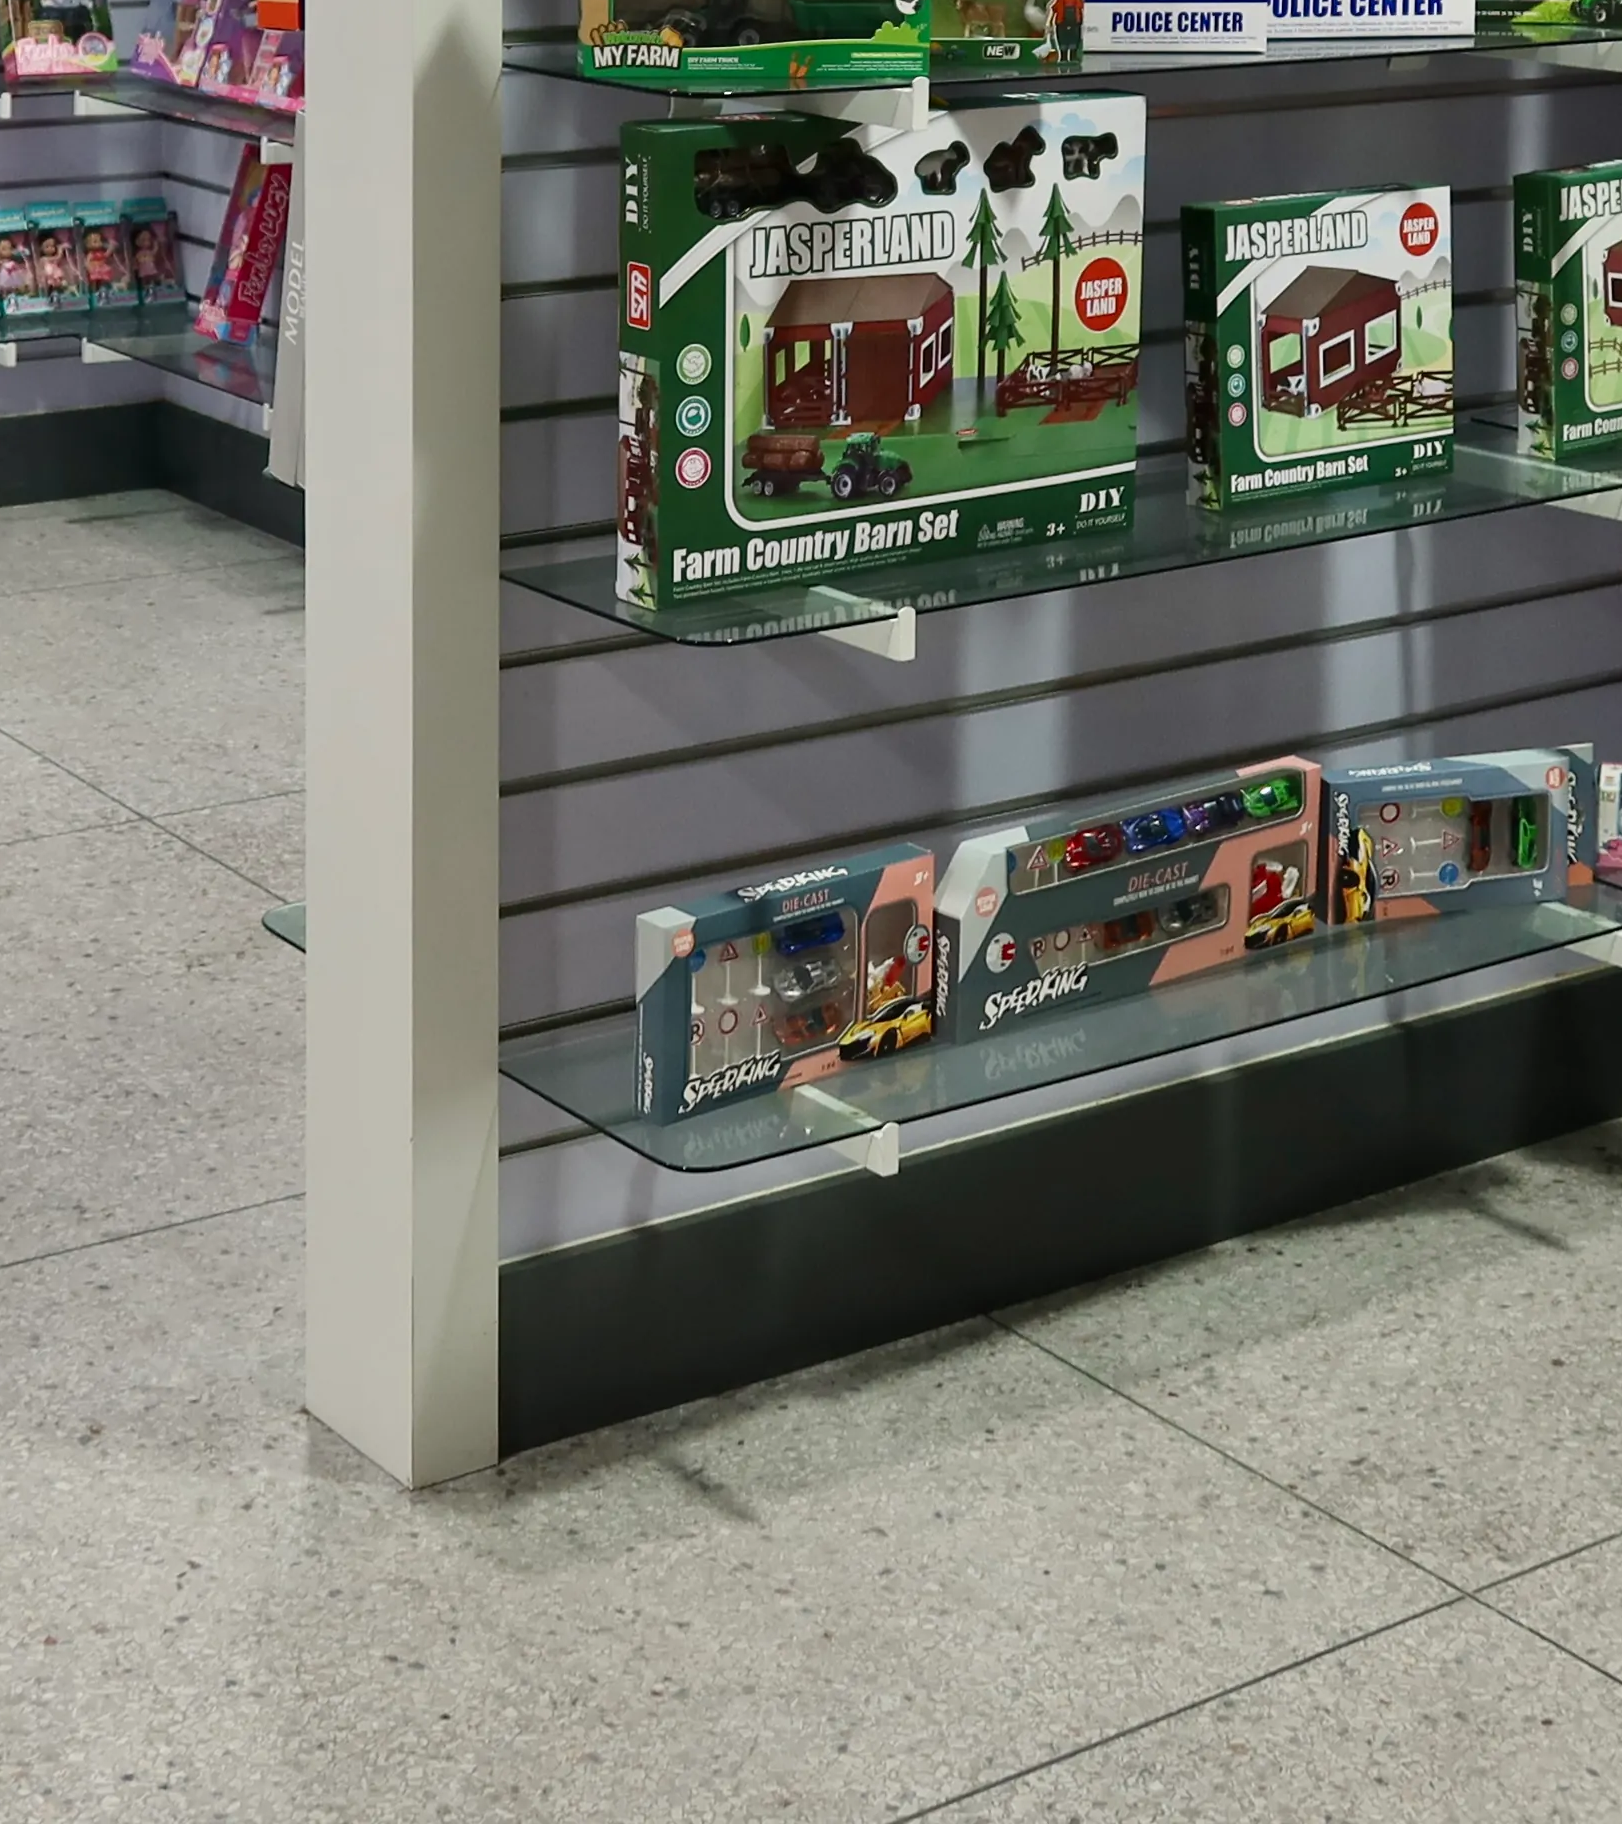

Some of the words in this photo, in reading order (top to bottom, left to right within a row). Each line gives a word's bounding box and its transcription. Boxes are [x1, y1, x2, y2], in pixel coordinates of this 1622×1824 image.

[1111, 12, 1173, 34] POLICE
[1177, 11, 1244, 34] CENTER
[593, 44, 625, 69] MY
[626, 44, 680, 69] FARM
[987, 44, 1017, 59] NEW
[623, 156, 640, 225] DIY
[1224, 210, 1368, 262] JASPERLAND
[1402, 217, 1435, 235] JASPER
[1406, 229, 1431, 247] LAND
[749, 211, 956, 277] JASPERLAND
[285, 240, 305, 346] MODEL
[1079, 276, 1124, 302] JASPER
[1085, 295, 1117, 318] LAND
[1562, 421, 1591, 442] Farm
[1412, 440, 1446, 460] DIY
[1230, 474, 1262, 494] Farm
[1264, 463, 1314, 489] Country
[1316, 459, 1346, 481] Barn
[1347, 455, 1369, 477] Set
[672, 547, 741, 583] Farm
[746, 527, 850, 575] Country
[854, 518, 914, 553] Barn
[918, 507, 961, 545] Set
[1127, 861, 1190, 894] DIE-CAST
